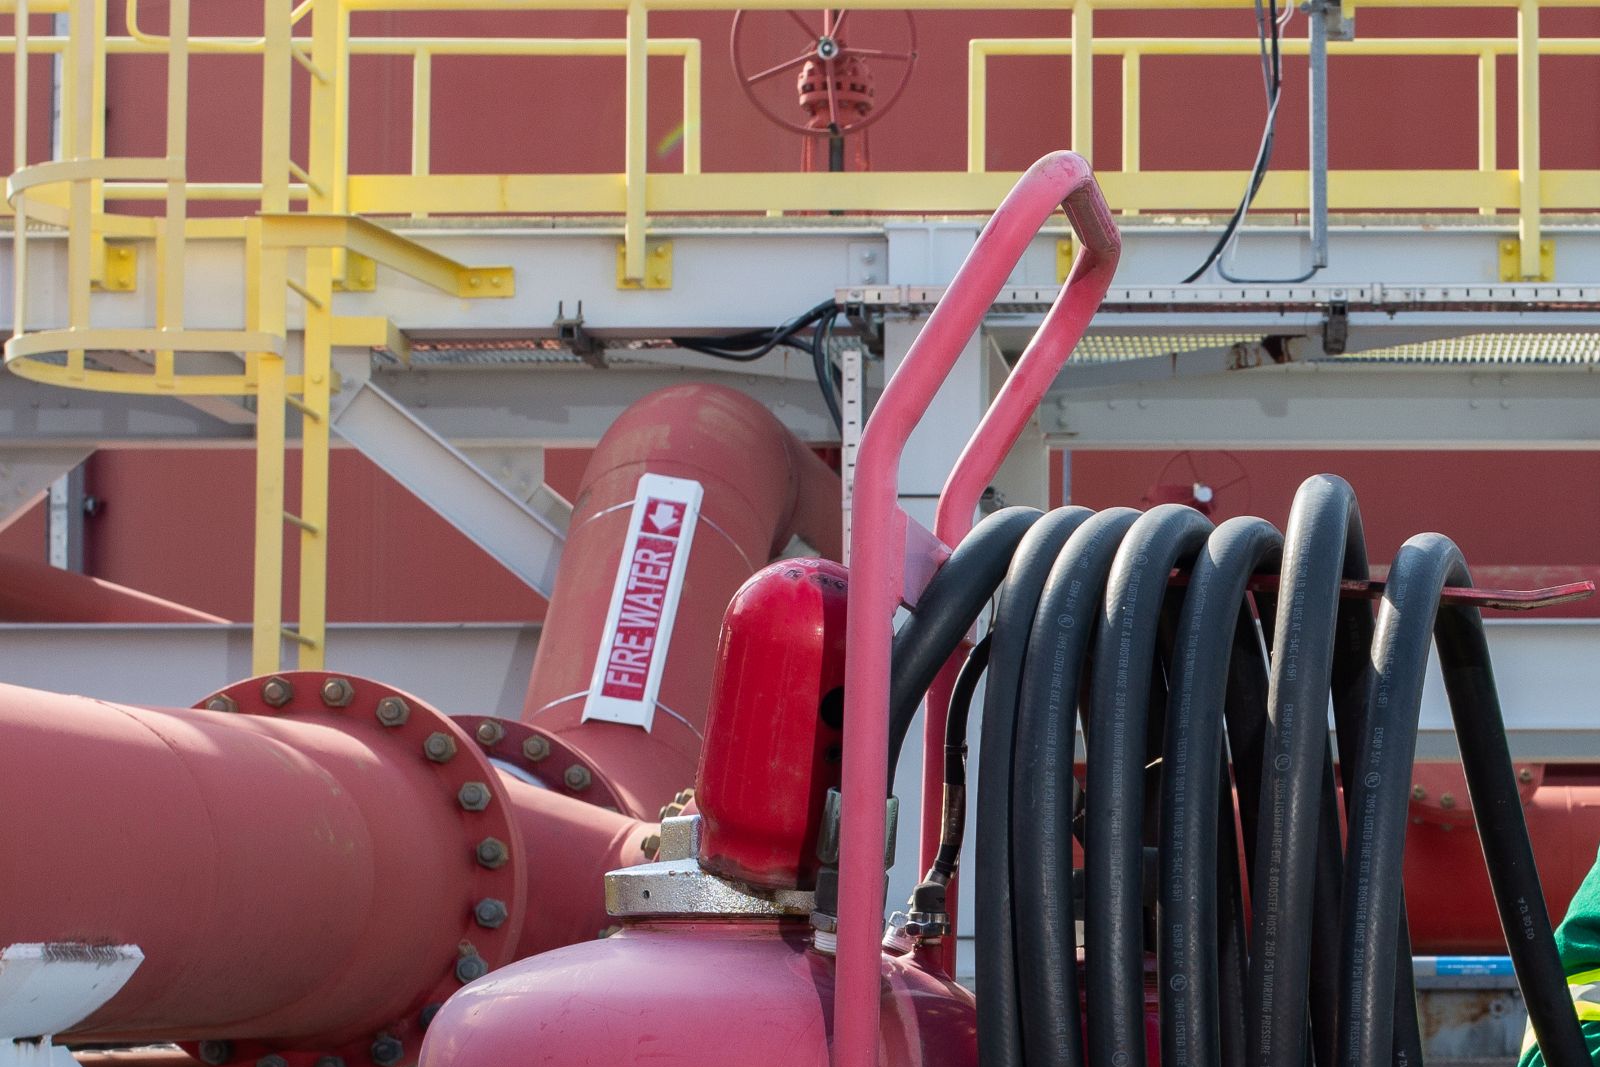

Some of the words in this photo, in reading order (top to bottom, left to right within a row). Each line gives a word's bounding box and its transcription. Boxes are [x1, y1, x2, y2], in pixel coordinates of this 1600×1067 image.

[620, 547, 673, 628] WATER
[1292, 607, 1304, 621] USE
[1291, 622, 1303, 631] AT
[606, 631, 653, 689] FIRE
[1053, 650, 1065, 671] LISTED
[1117, 638, 1130, 668] BOOSTER
[1116, 669, 1128, 688] HOSE
[1115, 692, 1126, 706] 250
[1115, 708, 1126, 720] PSI
[1179, 694, 1193, 729] PRESSURE
[1282, 703, 1294, 728] EX589
[1047, 713, 1059, 745] BOOSTER
[1113, 722, 1125, 757] WORKING
[1047, 747, 1058, 767] HOSE
[1176, 737, 1189, 762] TESTED
[1111, 760, 1123, 798] PRESSURE
[1175, 765, 1186, 774] TO
[1174, 777, 1185, 791] 500
[1173, 807, 1184, 822] FOR
[1365, 794, 1378, 814] 2095
[1046, 802, 1056, 839] WORKING
[1111, 807, 1122, 834] TESTED
[1362, 816, 1375, 840] LISTED
[1173, 824, 1183, 839] USE
[1271, 830, 1283, 848] FIRE
[1173, 841, 1183, 850] AT
[1360, 842, 1372, 858] FIRE
[1046, 890, 1058, 917] TESTED
[1266, 876, 1279, 912] BOOSTER
[1355, 885, 1368, 920] BOOSTER
[1173, 924, 1184, 948] EX589
[1266, 915, 1277, 937] HOSE
[1354, 923, 1365, 943] HOSE
[1525, 927, 1535, 940] 03
[1265, 940, 1276, 957] 250
[1353, 948, 1364, 963] 250
[1264, 959, 1275, 972] PSI
[1353, 966, 1364, 978] PSI
[1262, 974, 1275, 1012] WORKING
[1351, 981, 1363, 1018] WORKING
[1174, 997, 1186, 1019] 2095
[1175, 1021, 1186, 1047] LISTED
[1261, 1015, 1272, 1055] PRESSURE
[1349, 1021, 1361, 1061] PRESSURE
[1176, 1049, 1187, 1067] FIRE
[1397, 1050, 1406, 1058] A
[1398, 1059, 1408, 1067] 12
